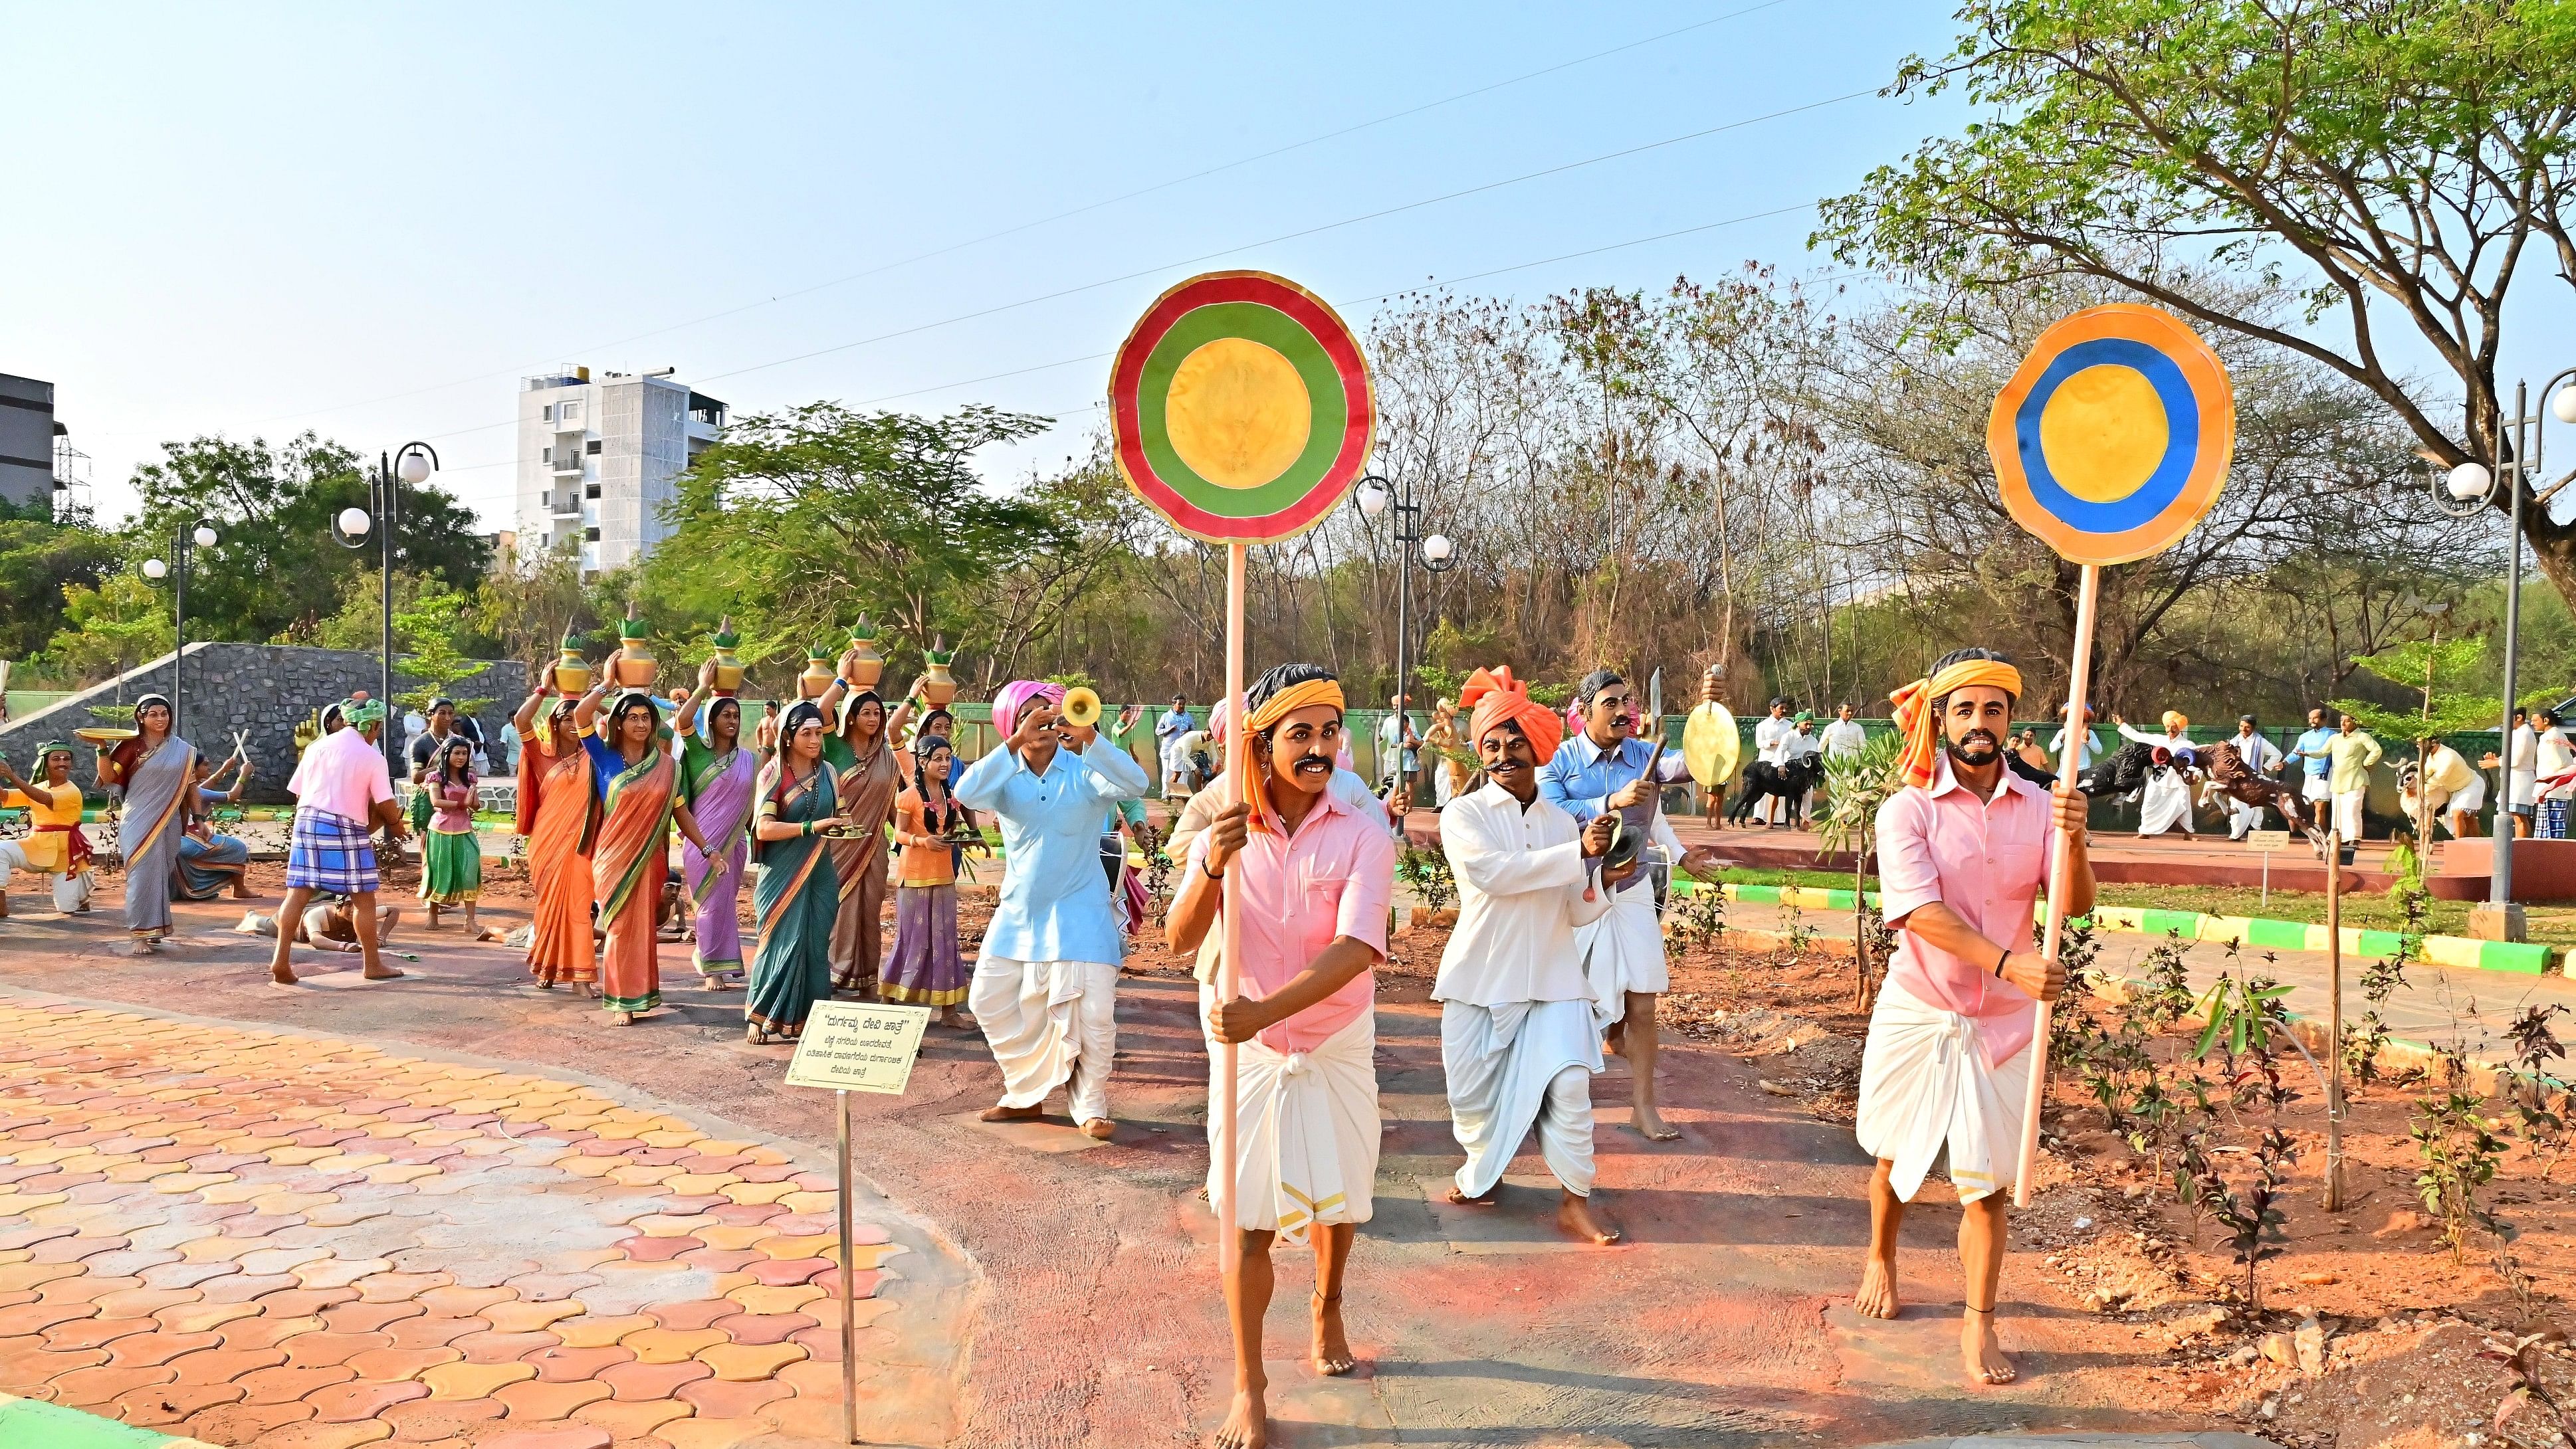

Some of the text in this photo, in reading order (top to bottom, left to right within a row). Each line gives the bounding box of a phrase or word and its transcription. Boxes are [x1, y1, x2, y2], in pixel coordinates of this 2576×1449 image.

[863, 1018, 881, 1029] ದೇವಿ
[835, 1036, 858, 1046] ನಗರಿಯ
[830, 1065, 867, 1078] ದೇವಿಯ ಜಾತ್ರೆ
